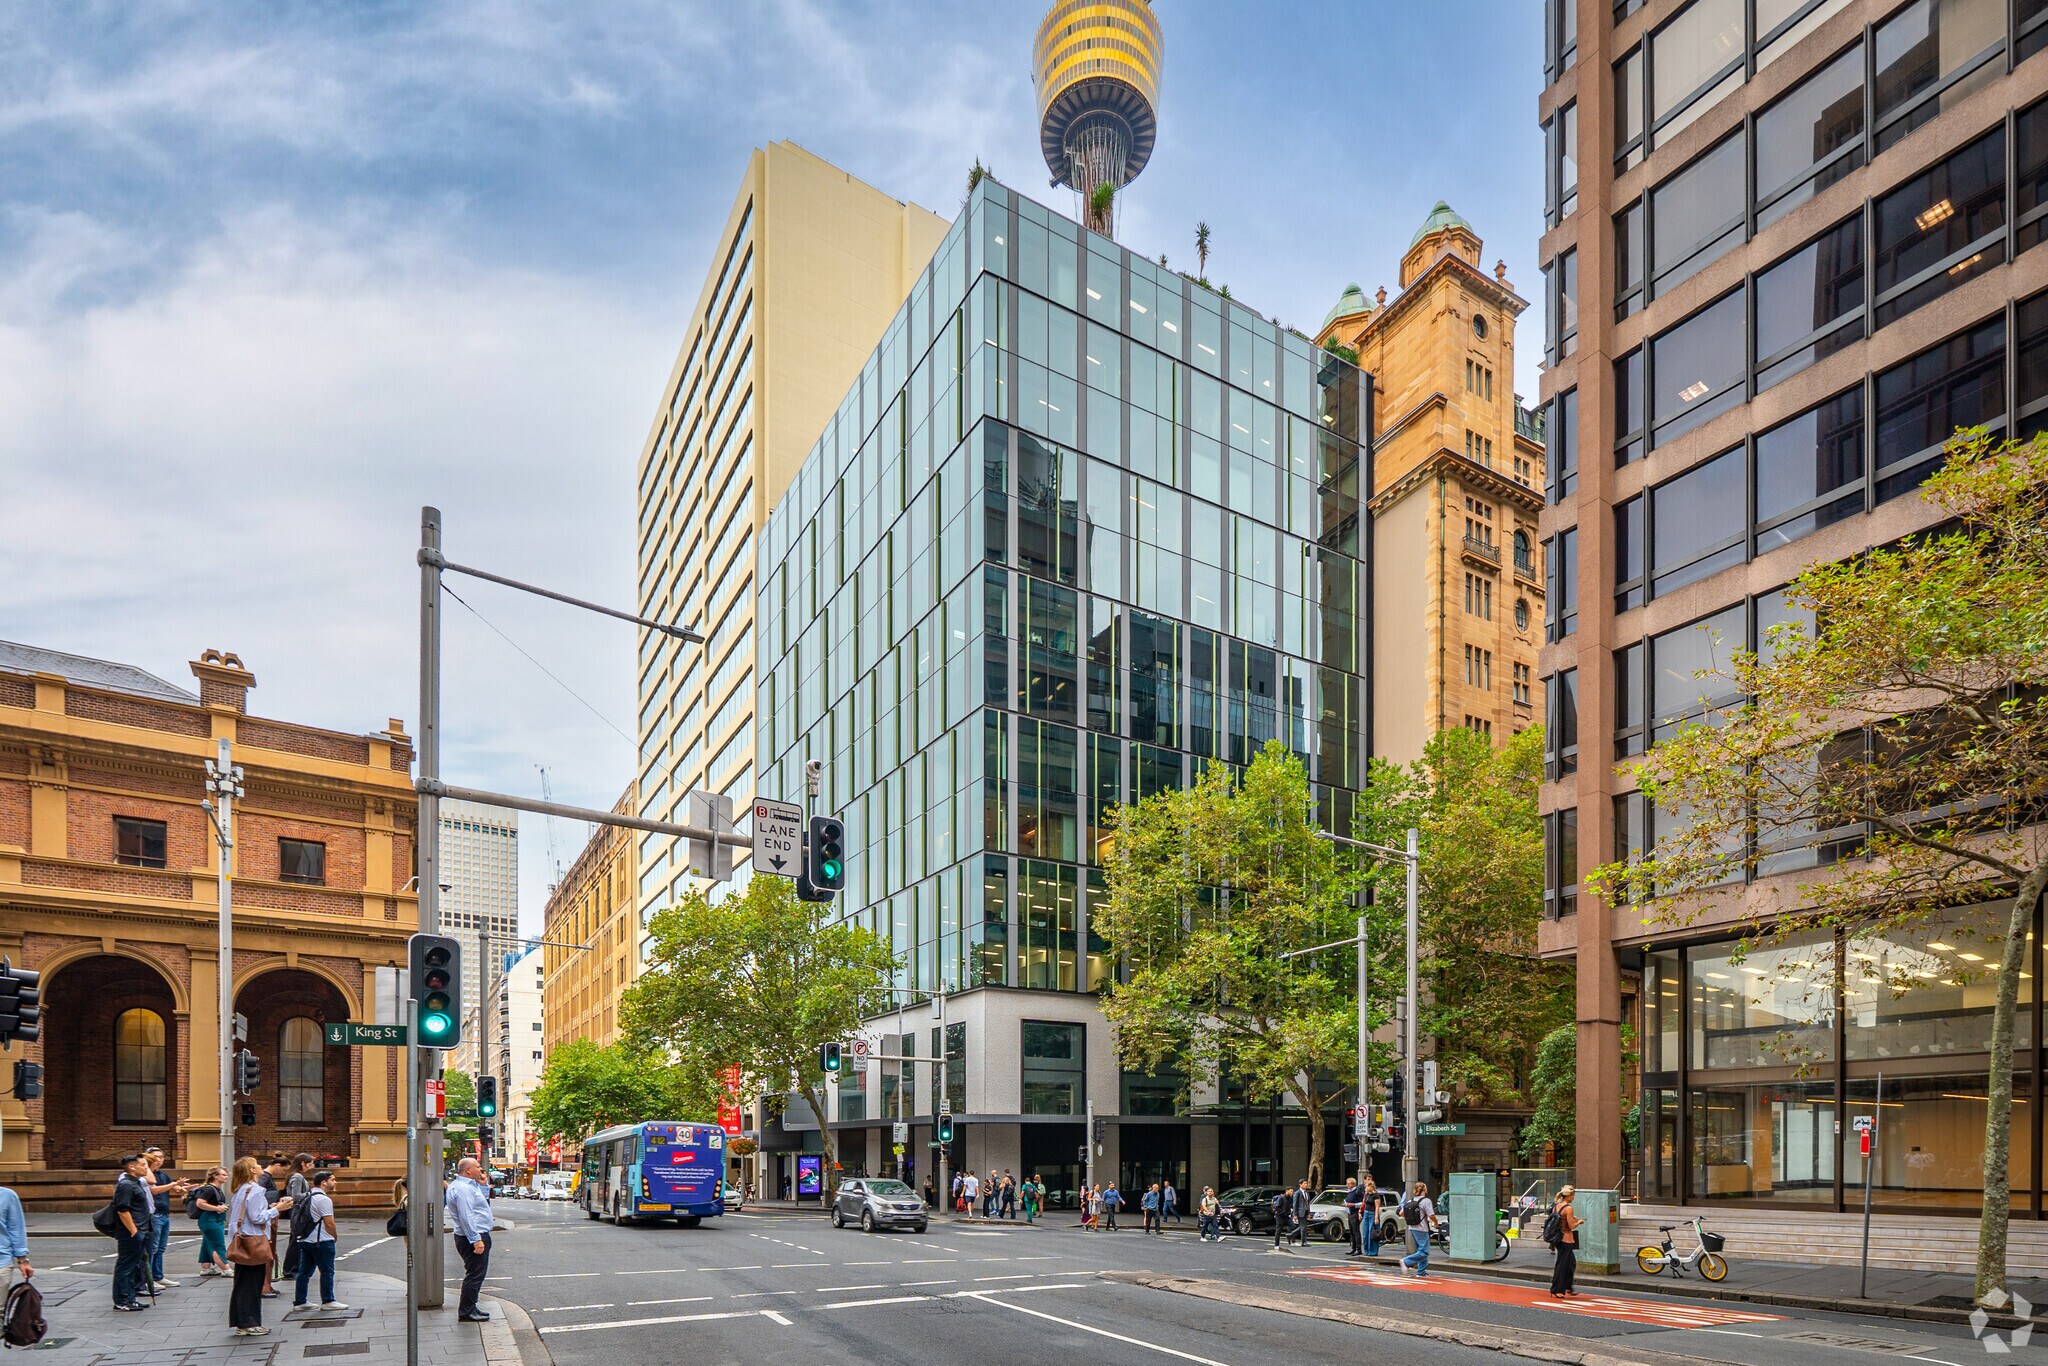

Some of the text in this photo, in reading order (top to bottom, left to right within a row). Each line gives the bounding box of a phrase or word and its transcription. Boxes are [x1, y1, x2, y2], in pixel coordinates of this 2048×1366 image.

[760, 822, 796, 838] LANE
[764, 838, 792, 851] END
[355, 1026, 397, 1040] King St
[650, 1136, 666, 1145] 412
[678, 1130, 691, 1139] 40
